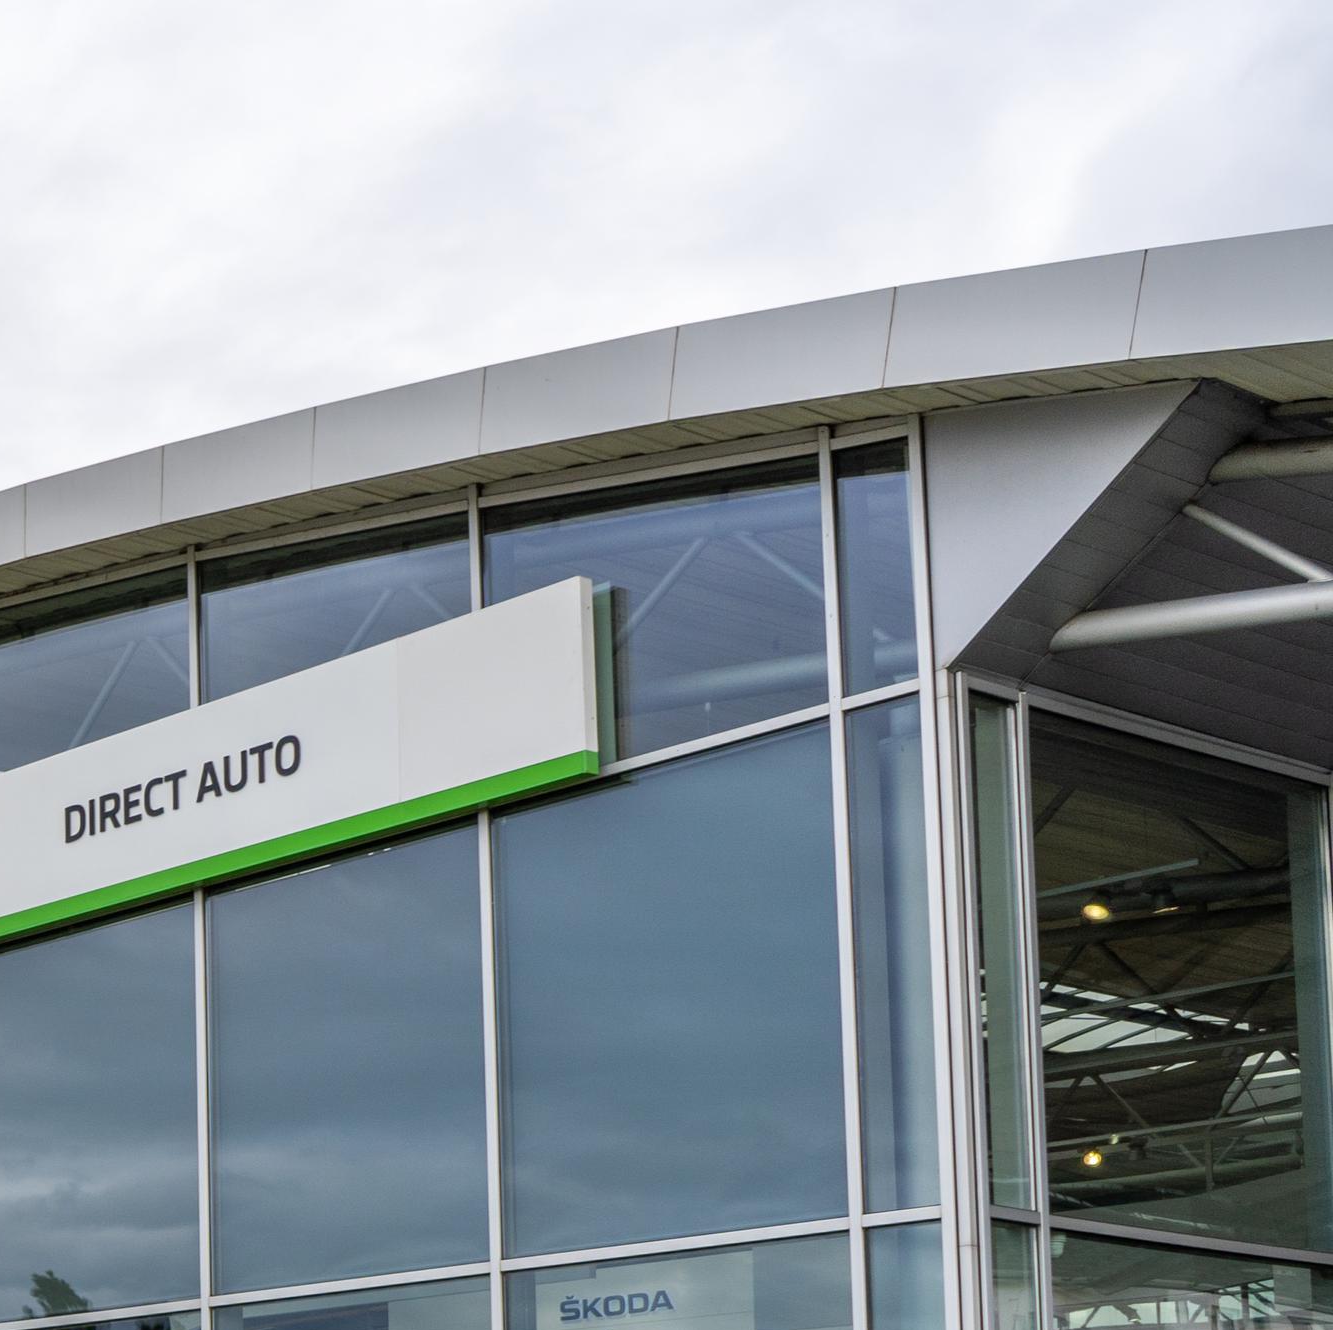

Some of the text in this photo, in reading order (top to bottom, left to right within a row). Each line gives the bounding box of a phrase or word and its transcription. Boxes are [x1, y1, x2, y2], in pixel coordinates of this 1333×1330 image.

[64, 735, 301, 844] DIRECT AUTO
[559, 1290, 675, 1322] ŠKODA
